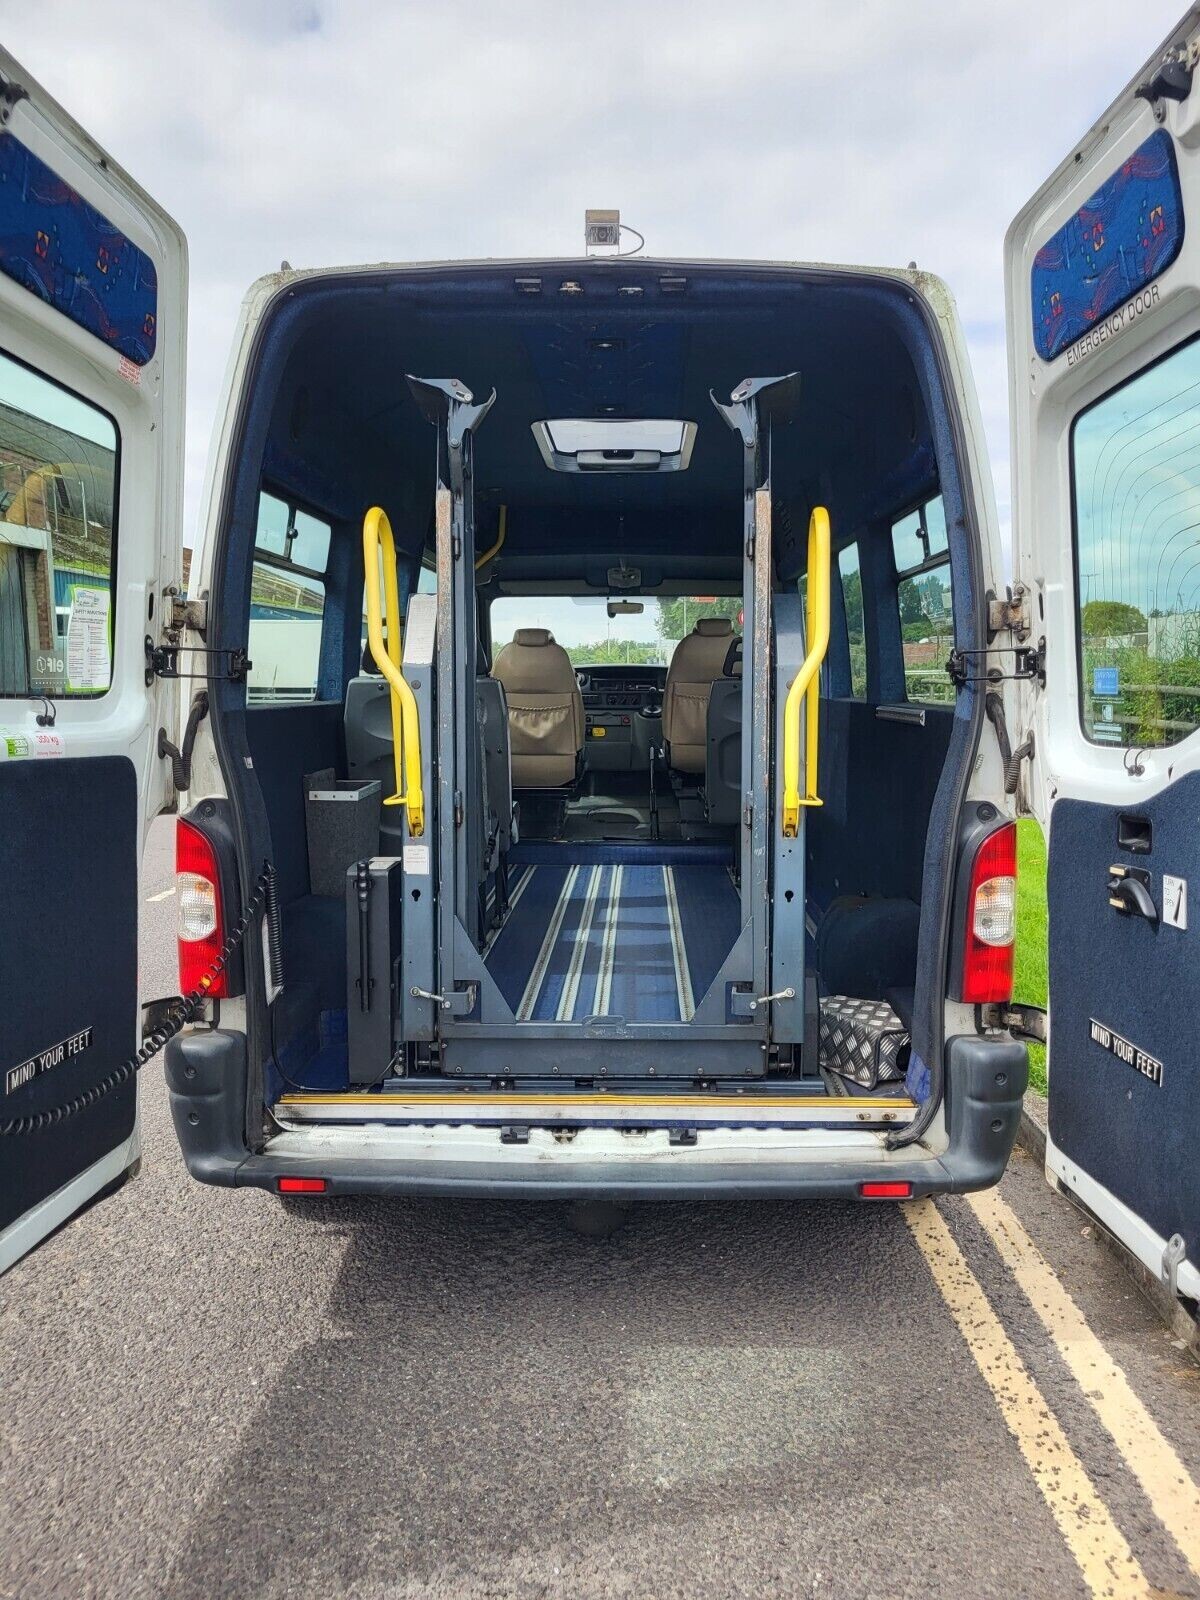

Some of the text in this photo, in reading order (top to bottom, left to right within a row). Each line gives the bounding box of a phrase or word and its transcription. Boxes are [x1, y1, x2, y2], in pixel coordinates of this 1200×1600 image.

[1066, 284, 1160, 366] EMERGENCY DOOR
[11, 1031, 90, 1090] MIND YOUR FEET
[1091, 1022, 1159, 1081] MIND YOUR FEET
